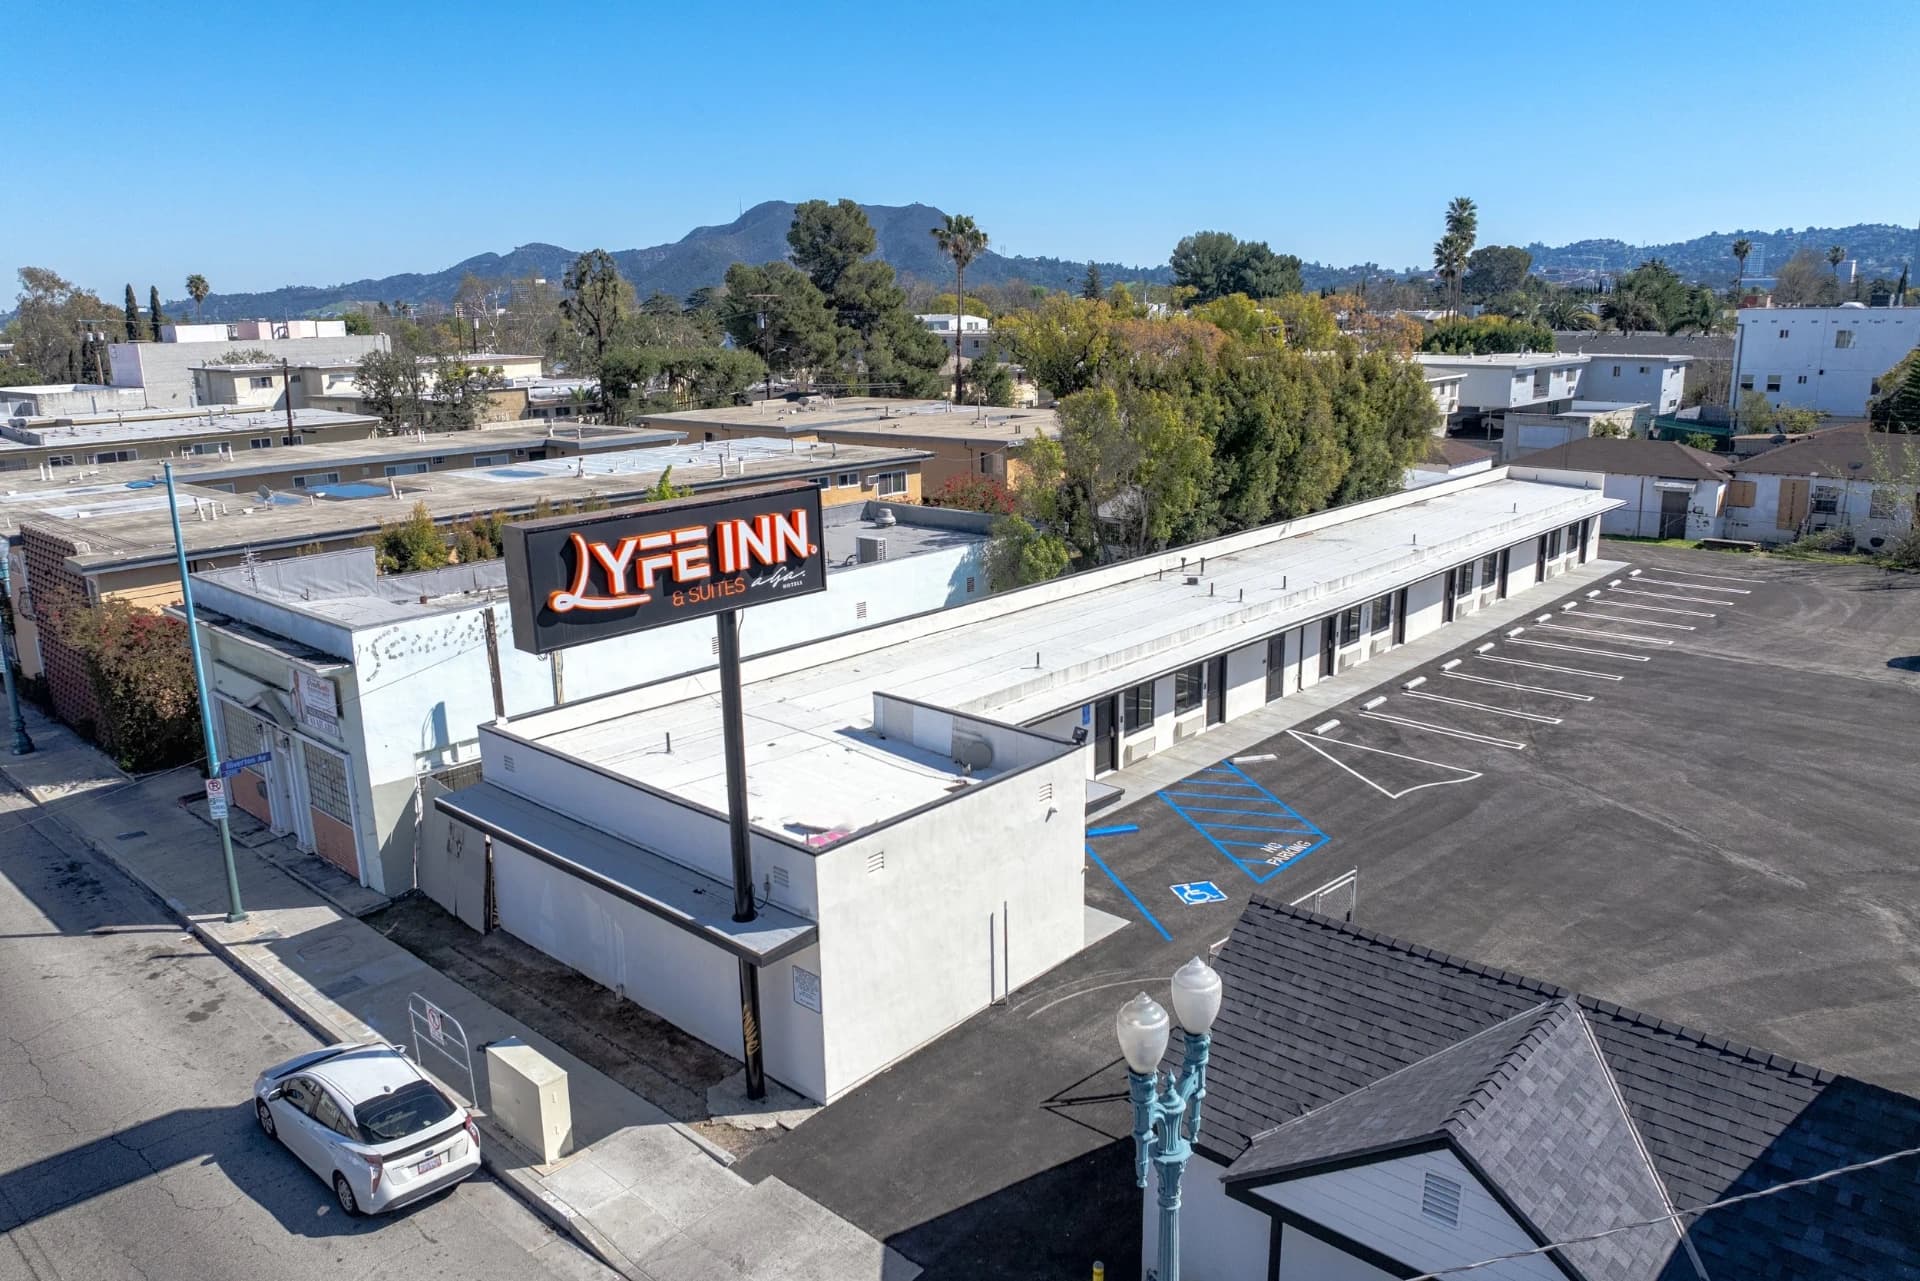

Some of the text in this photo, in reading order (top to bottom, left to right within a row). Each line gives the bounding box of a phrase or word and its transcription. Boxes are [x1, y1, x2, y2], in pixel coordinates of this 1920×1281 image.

[547, 525, 711, 613] LYFE
[672, 577, 745, 607] & SUITES
[782, 580, 803, 589] HOTELS
[1260, 842, 1283, 853] NO
[1264, 840, 1312, 867] PARKING
